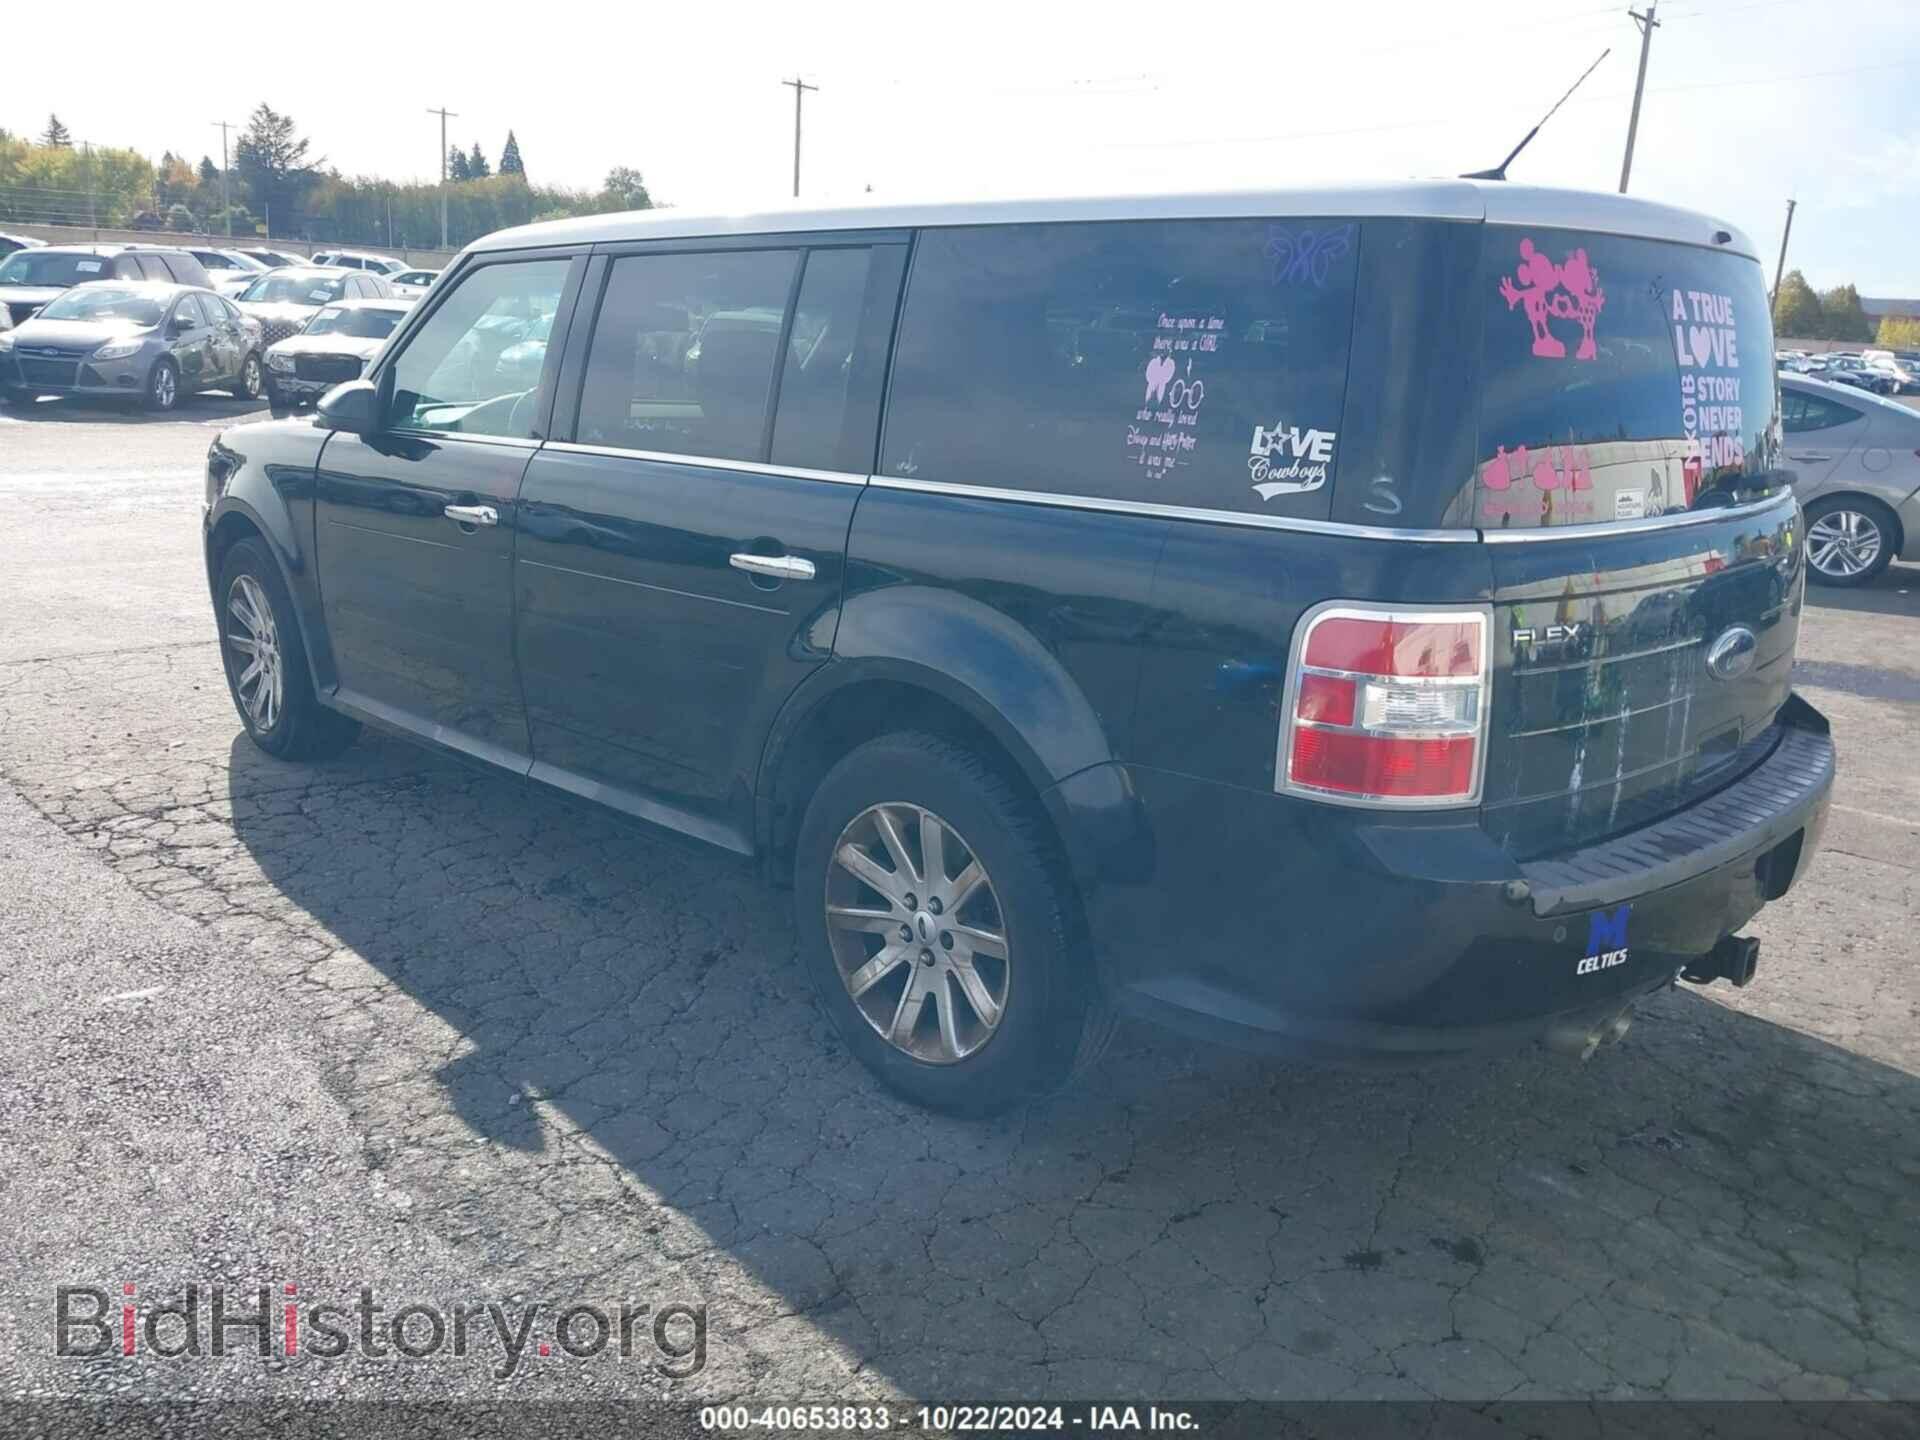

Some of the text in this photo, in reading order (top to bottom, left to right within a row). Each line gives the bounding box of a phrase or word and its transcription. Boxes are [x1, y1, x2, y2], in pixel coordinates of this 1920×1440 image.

[1672, 288, 1735, 326] A TRUE
[1697, 375, 1741, 402] STORY
[1699, 406, 1743, 433] NEVER
[1700, 436, 1744, 468] ENDS
[1247, 456, 1326, 489] Cowboys
[1512, 624, 1582, 647] FLEX
[1576, 948, 1628, 975] CELTICS
